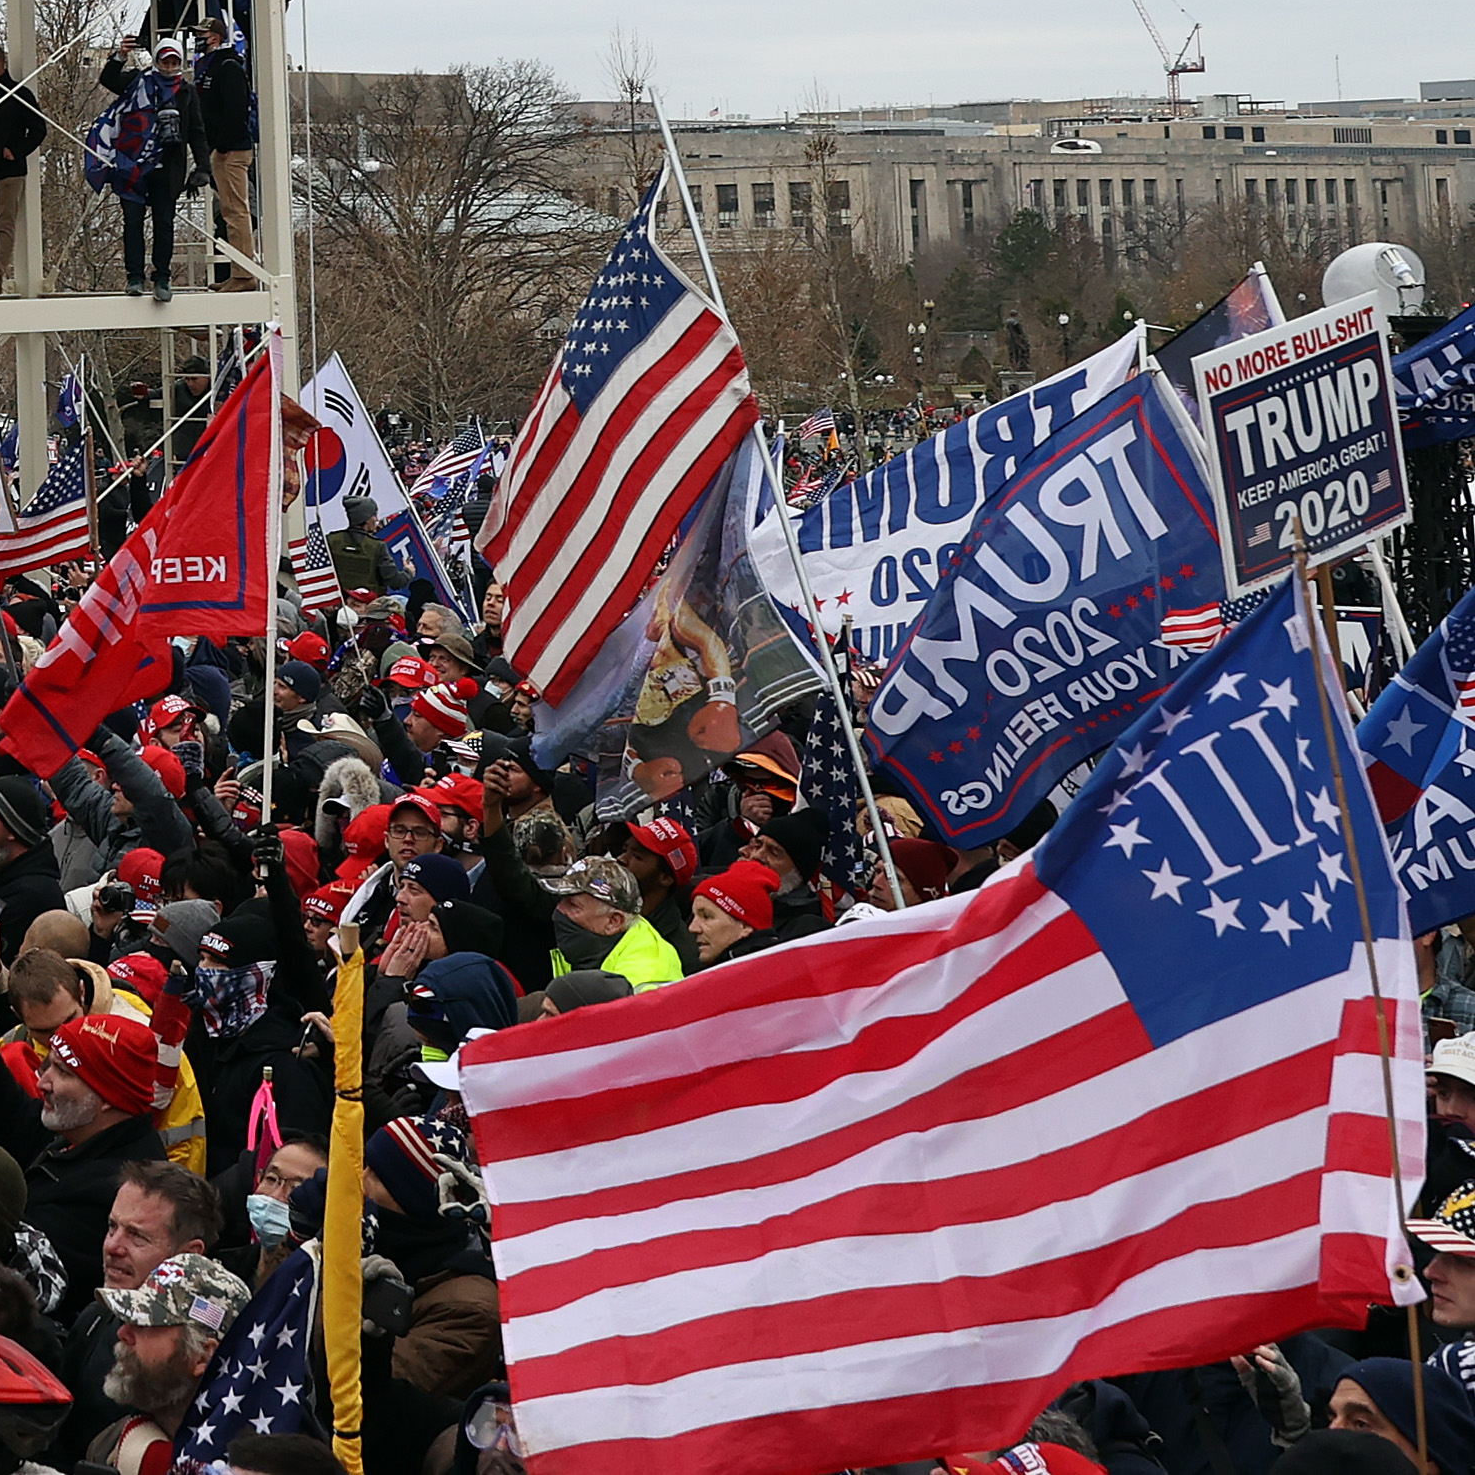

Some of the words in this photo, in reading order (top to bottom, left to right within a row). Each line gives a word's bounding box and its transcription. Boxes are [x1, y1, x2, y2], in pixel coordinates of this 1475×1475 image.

[1204, 362, 1234, 394] NO
[1235, 347, 1289, 385] MORE
[1293, 307, 1374, 363] BULLSHIT
[1223, 357, 1379, 477] TRUMP
[1237, 480, 1277, 510] KEEP
[1278, 456, 1339, 494] AMERICA
[1273, 469, 1371, 551] 2020
